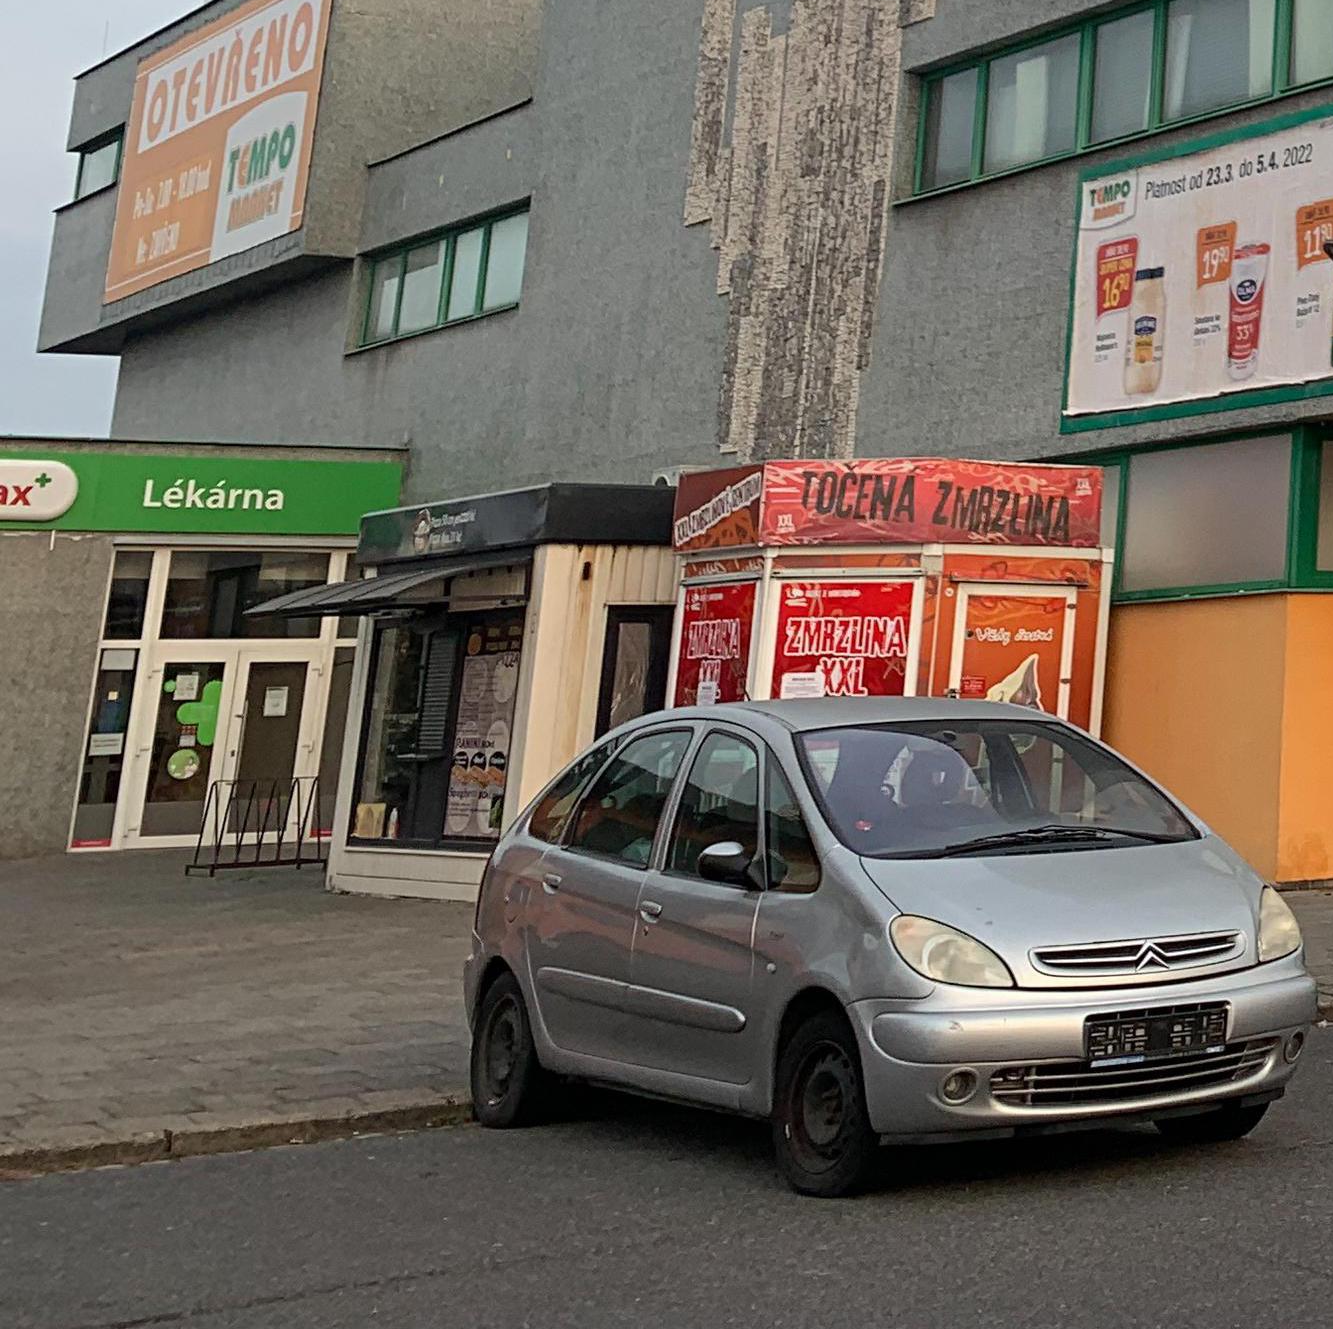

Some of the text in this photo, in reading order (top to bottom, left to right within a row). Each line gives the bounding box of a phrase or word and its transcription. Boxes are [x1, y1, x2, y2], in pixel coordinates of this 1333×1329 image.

[147, 1, 313, 142] OTEVŘENO
[227, 124, 296, 193] TEMPO
[1145, 143, 1313, 200] Platnost od 23.3. do 5.4. 2022
[1090, 180, 1131, 206] TEMPO
[143, 479, 285, 511] Lékárna
[931, 480, 1070, 542] ZMRZLINA
[784, 616, 907, 657] ZMRZLINA
[820, 657, 868, 696] XXL
